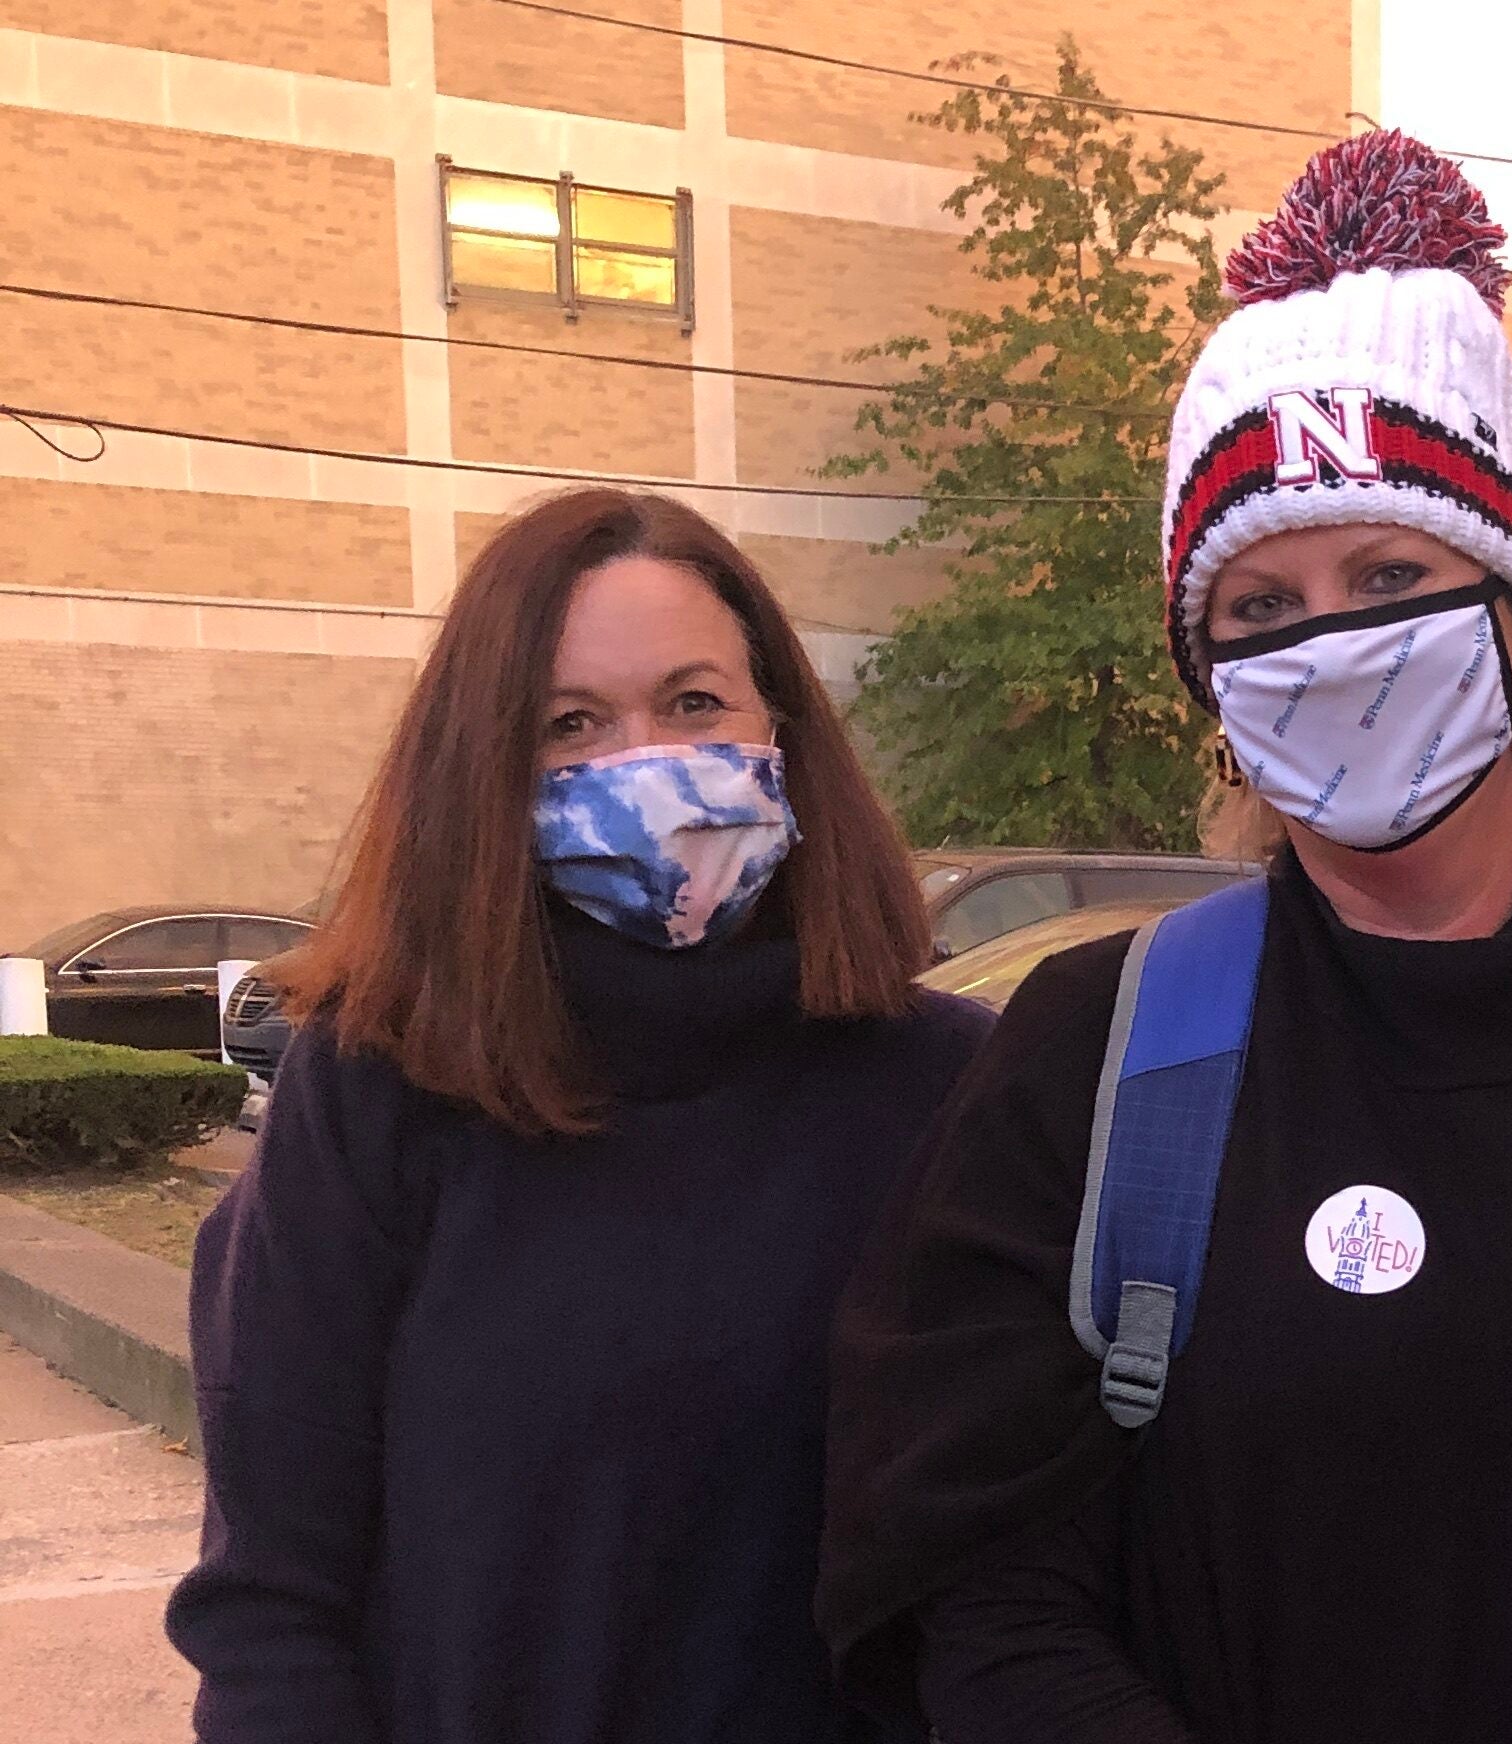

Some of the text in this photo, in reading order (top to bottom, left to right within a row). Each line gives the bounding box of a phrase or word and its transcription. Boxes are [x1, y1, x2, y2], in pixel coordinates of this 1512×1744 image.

[1268, 387, 1383, 486] N
[1365, 629, 1416, 718] Penn Medicine
[1464, 647, 1484, 679] Penn
[1394, 731, 1445, 820] Penn Medicine
[1327, 1225, 1418, 1273] VOTED!
[1372, 1212, 1384, 1231] I
